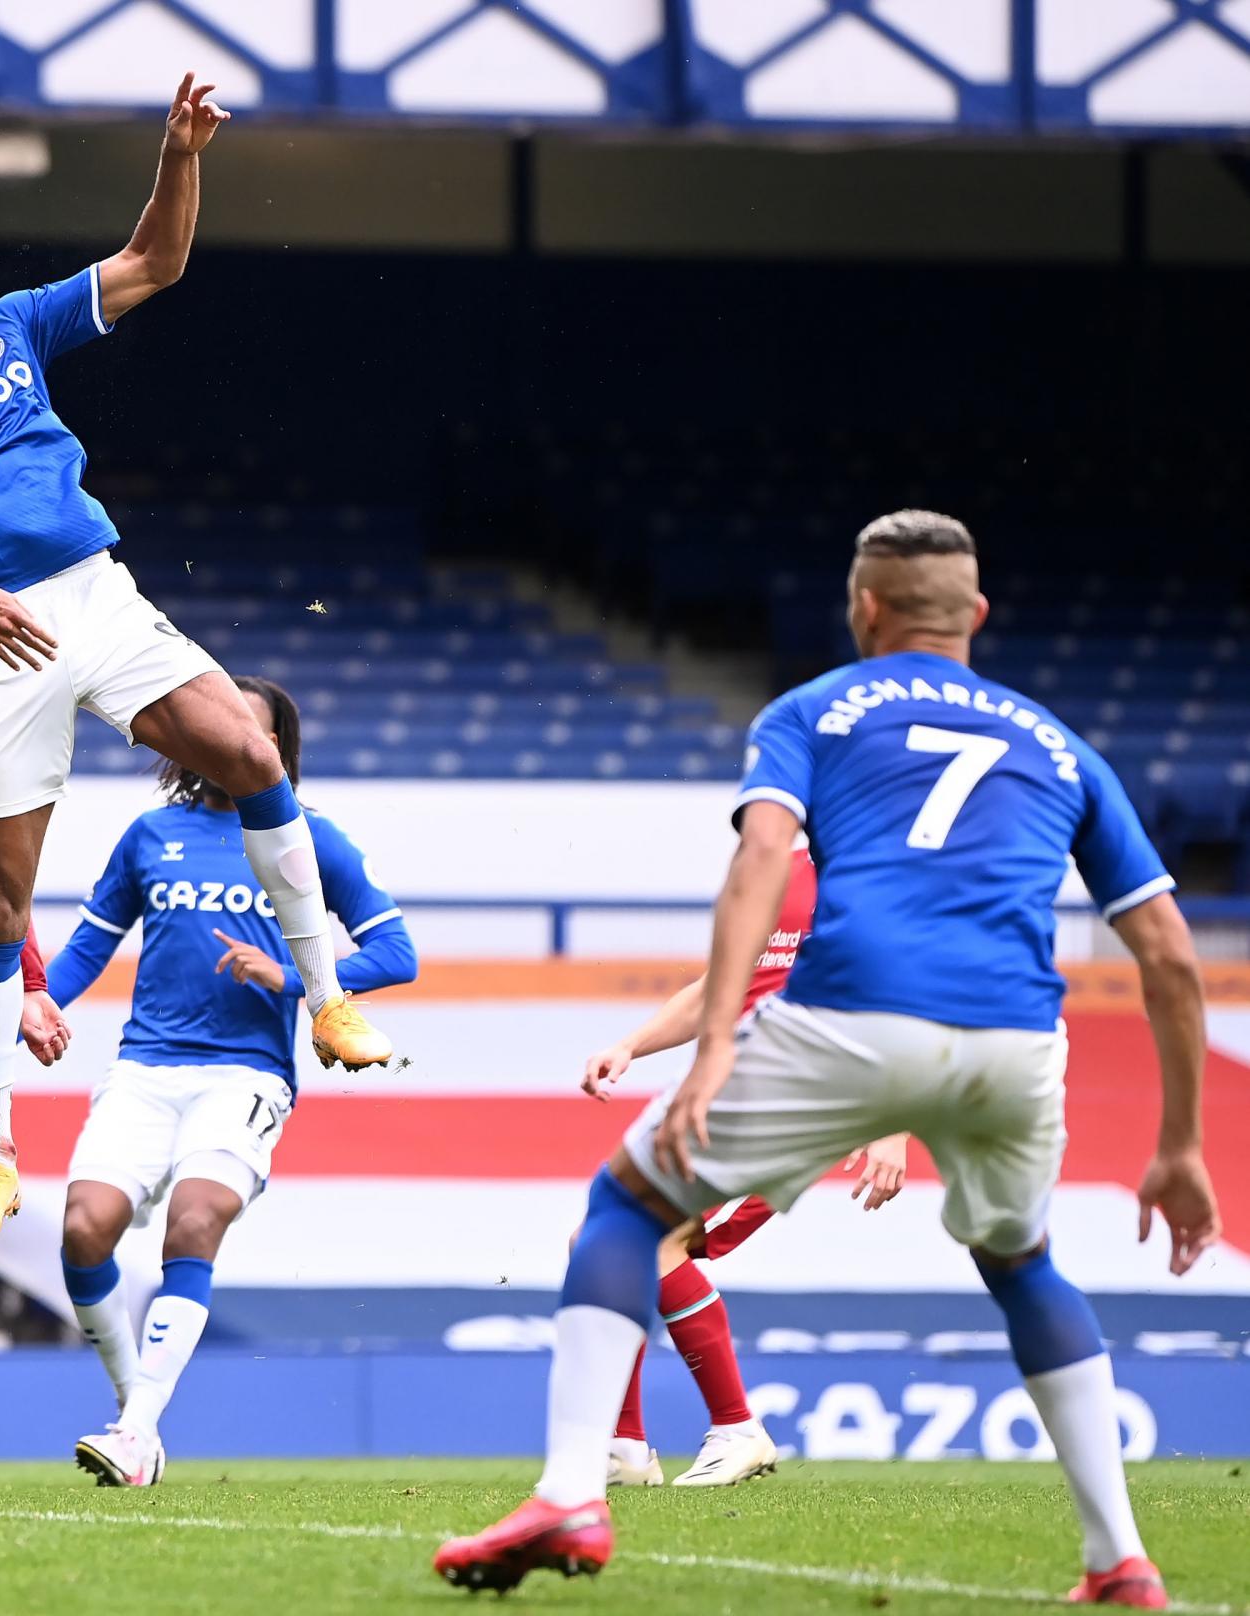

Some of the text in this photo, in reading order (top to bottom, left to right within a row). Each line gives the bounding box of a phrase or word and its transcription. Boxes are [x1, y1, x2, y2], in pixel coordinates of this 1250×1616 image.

[815, 677, 1081, 784] RICHARLISON
[905, 724, 1010, 850] 7
[757, 949, 797, 968] rtered
[768, 928, 801, 948] dard
